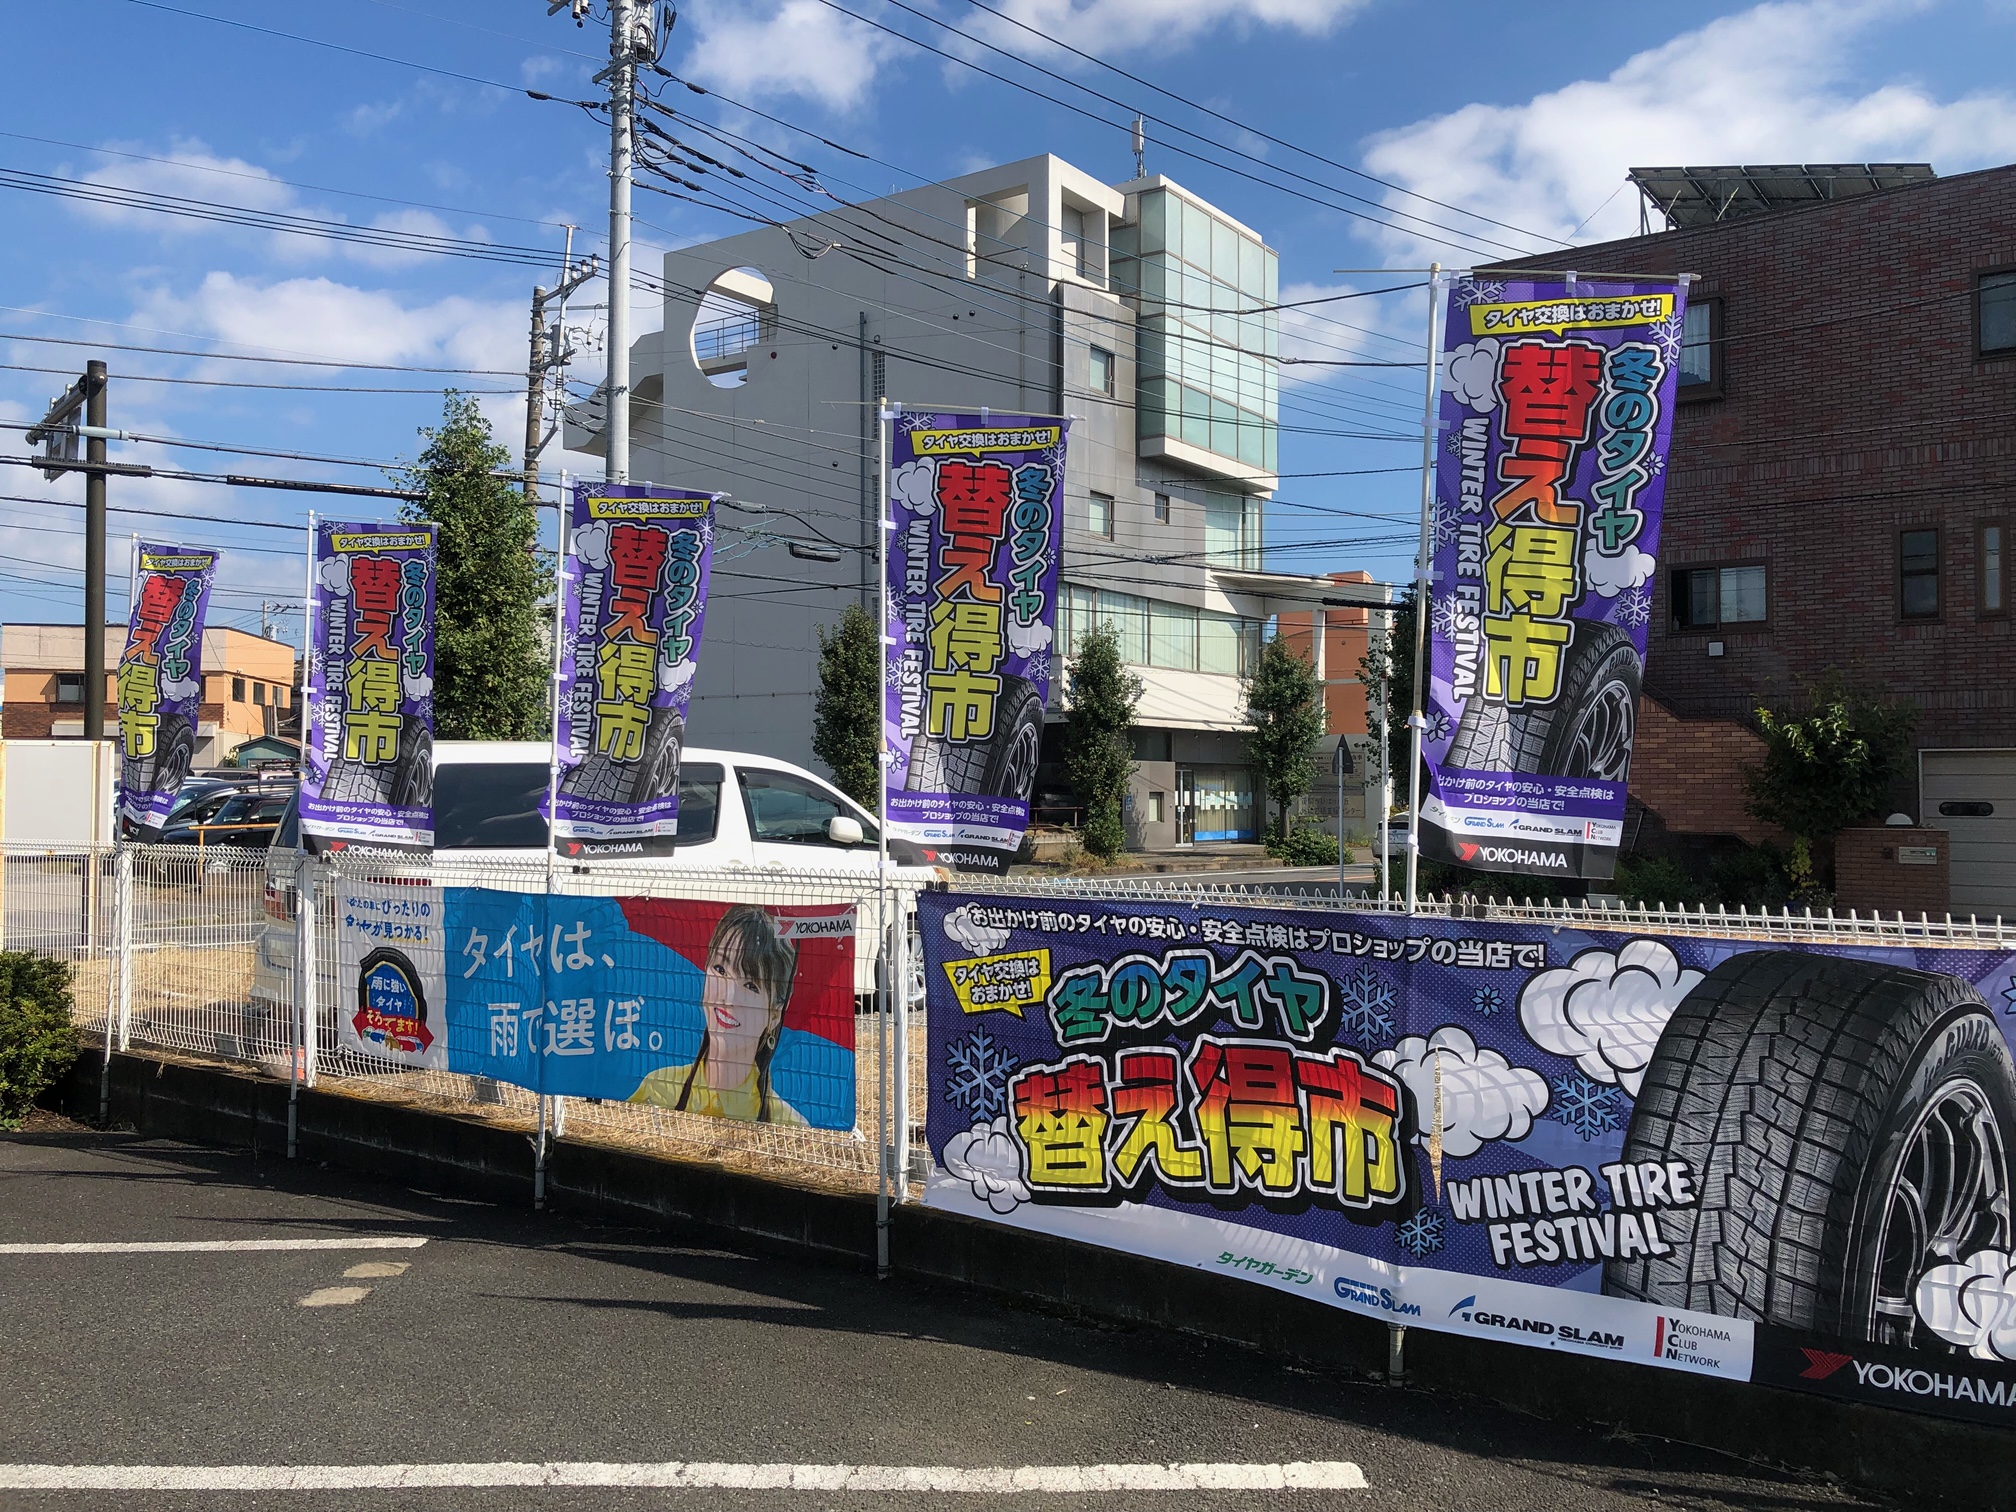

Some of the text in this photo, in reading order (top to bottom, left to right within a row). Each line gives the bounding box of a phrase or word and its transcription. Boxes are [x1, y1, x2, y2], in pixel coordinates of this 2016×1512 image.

[1485, 299, 1661, 329] タイヤ交換はおまかせ!
[923, 431, 1051, 449] タイヤ交換はおまかせ!
[1596, 349, 1658, 547] 冬のタイヤ
[598, 502, 702, 514] タイヤ交換はおまかせ!
[1485, 345, 1601, 702] 替え得市
[1013, 467, 1050, 620] 冬のタイヤ
[1452, 418, 1489, 699] WINTER TIRE FESTIVAL
[404, 561, 427, 673] 冬のタイヤ
[663, 532, 700, 661] 冬のタイヤ
[927, 464, 1011, 739] 替え得市
[164, 579, 201, 678] 冬のタイヤ
[598, 525, 669, 759] 替え得市
[900, 520, 931, 739] WINTER TIRE FESTIVAL
[118, 574, 187, 757] 替え得市
[323, 599, 347, 761] WINTER TIRE FESTIVAL
[346, 557, 402, 763] 替え得市
[569, 573, 604, 757] WINTER TIRE FESTIVAL
[1437, 775, 1615, 801] 出かけ前のタイヤの安心・安全点検は
[1463, 793, 1565, 811] プロショップの当店で!
[348, 844, 404, 857] YOKOHAMA
[583, 842, 643, 855] YOKOHAMA
[1519, 824, 1582, 836] GRAND SLAM
[937, 852, 999, 868] YOKOHAMA
[1479, 847, 1568, 868] YOKOHAMA
[795, 918, 852, 934] YOKOHAMA
[970, 906, 1545, 968] お出かけ前のタイヤの安心・安全点検はプロショップの当店で!
[463, 921, 615, 979] タイヤは、
[953, 958, 1040, 985] タイヤ交換は
[371, 976, 407, 994] 雨に強い
[376, 996, 403, 1012] タイヤ
[971, 980, 1032, 1005] おまかせ!
[1056, 958, 1320, 1037] 冬のタイヤ
[488, 996, 663, 1058] 雨で選ぼ。
[1944, 1020, 1990, 1067] GUARD
[1015, 1043, 1398, 1198] 替え得市
[1447, 1162, 1696, 1220] WINTER TIRE
[1489, 1212, 1671, 1265] FESTIVAL
[1216, 1251, 1314, 1285] タイヤガーデン
[1334, 1276, 1421, 1316] GRAND SLAM
[1474, 1311, 1625, 1347] GRAND SLAM
[1667, 1334, 1698, 1351] CLUB
[1669, 1318, 1731, 1342] YOKOHAMA
[1665, 1348, 1721, 1369] NETWORK
